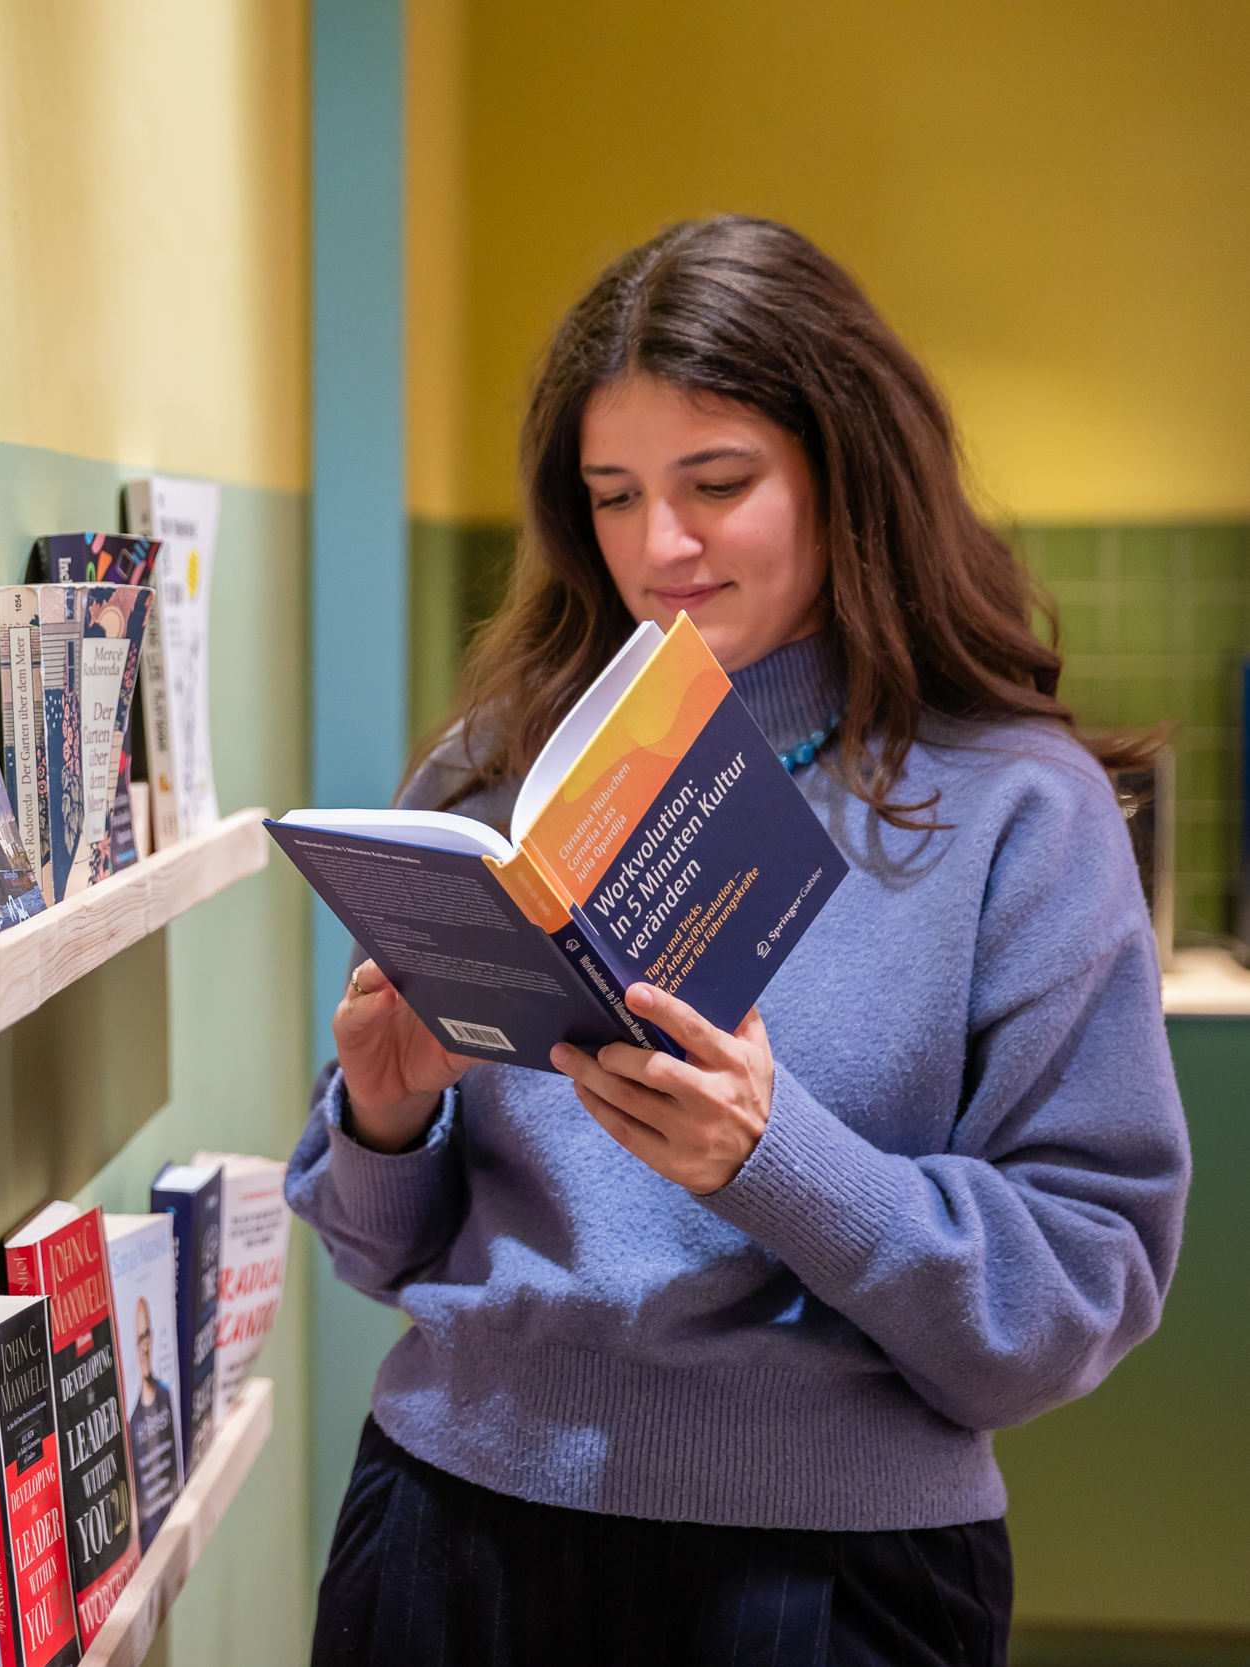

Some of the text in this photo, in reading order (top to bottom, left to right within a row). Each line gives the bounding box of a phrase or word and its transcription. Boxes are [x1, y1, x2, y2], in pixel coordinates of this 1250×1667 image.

[16, 636, 25, 666] Meer
[83, 662, 121, 677] Rodoreda
[94, 646, 124, 661] Mercè
[17, 668, 26, 691] dem
[18, 692, 28, 720] über
[93, 701, 114, 722] Der
[20, 723, 29, 759] Garten
[83, 725, 111, 745] Garten
[89, 748, 109, 768] über
[22, 763, 31, 785] Der
[90, 771, 106, 789] dem
[23, 793, 35, 846] Rodoreda
[87, 794, 105, 815] Meer
[558, 763, 631, 859] Christina Hübschen
[567, 805, 617, 871] Cornelia Lass
[575, 814, 627, 884] Julia Opardija
[594, 779, 699, 917] Workvolution:
[609, 752, 746, 940] In 5 Minuten Kultur
[626, 859, 702, 959] verändern
[667, 879, 736, 976] Arbeits(R)evolution
[768, 867, 823, 942] Springer Gabler
[644, 903, 703, 980] Tipps und Tricks
[666, 867, 760, 996] icht nur für Führungskräfte
[579, 954, 610, 995] Workvolution:
[605, 990, 615, 1001] In
[610, 997, 620, 1005] 5
[613, 1001, 634, 1027] Minuten
[629, 1022, 647, 1042] Kultur
[13, 1257, 28, 1292] JOHN
[48, 1221, 99, 1299] JOHN C.
[50, 1270, 109, 1340] MAXWELL
[0, 1333, 28, 1385] JOHN
[28, 1325, 41, 1357] C.
[60, 1344, 114, 1402] DEVELOPING
[0, 1363, 48, 1416] MAXWELL
[66, 1396, 122, 1471] LEADER
[10, 1462, 56, 1514] DEVELOPING
[81, 1451, 118, 1499] WITHIN
[30, 1499, 38, 1516] the
[75, 1480, 131, 1564] YOU 2.0
[15, 1507, 62, 1572] LEADER
[28, 1554, 58, 1597] WITHIN
[24, 1592, 53, 1652] YOU
